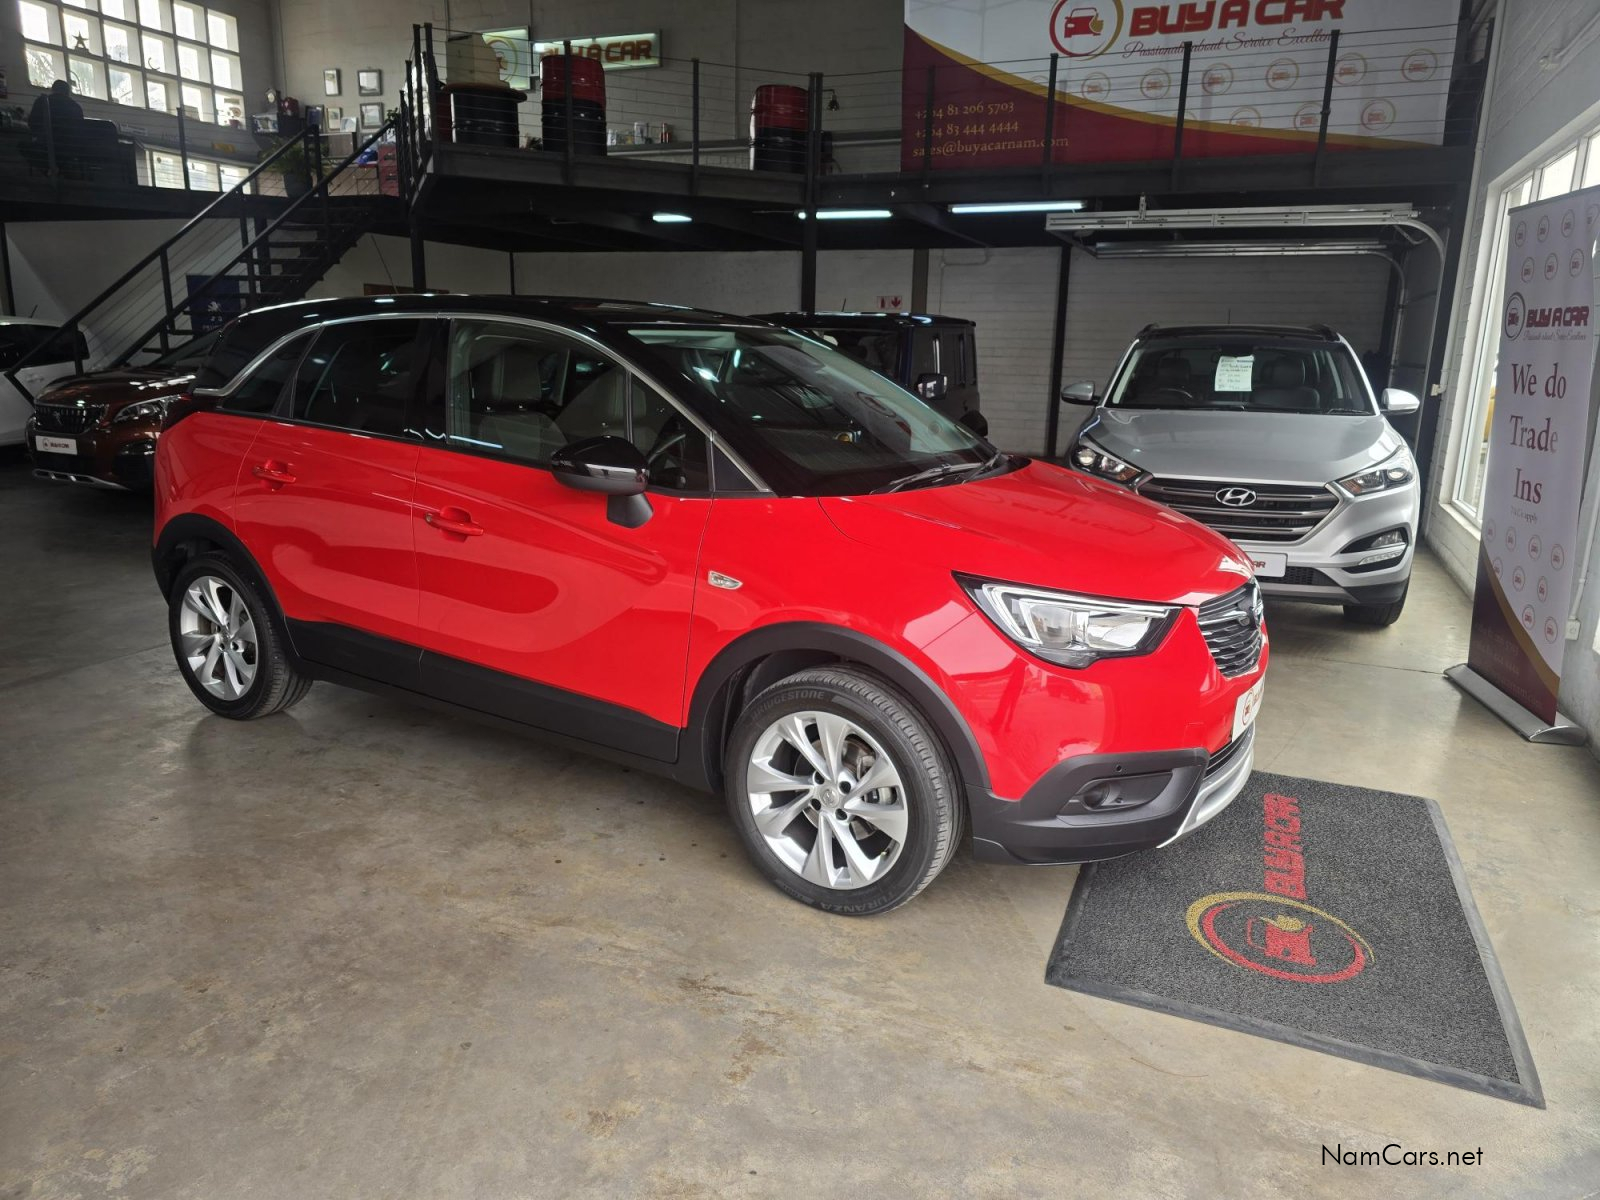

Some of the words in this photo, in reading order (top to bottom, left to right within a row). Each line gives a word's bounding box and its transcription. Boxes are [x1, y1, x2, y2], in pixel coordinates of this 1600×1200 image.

[1129, 0, 1217, 37] BUY
[1217, 0, 1250, 29] A
[1254, 0, 1346, 26] CAR
[606, 40, 653, 62] CAR
[1225, 31, 1275, 51] Service
[1277, 27, 1343, 46] Excellen
[946, 103, 959, 117] 81
[962, 100, 984, 115] 206
[987, 101, 1015, 116] 5703
[946, 123, 960, 136] 83
[962, 124, 985, 135] 444
[988, 120, 1019, 134] 4444
[912, 136, 1070, 157] saes@buyacarnam.com
[1511, 363, 1537, 396] We
[1544, 361, 1567, 399] do
[1509, 414, 1559, 454] Trade
[1513, 467, 1543, 504] Ins
[1252, 561, 1267, 569] AR
[752, 689, 826, 721] BRIDGESTONE
